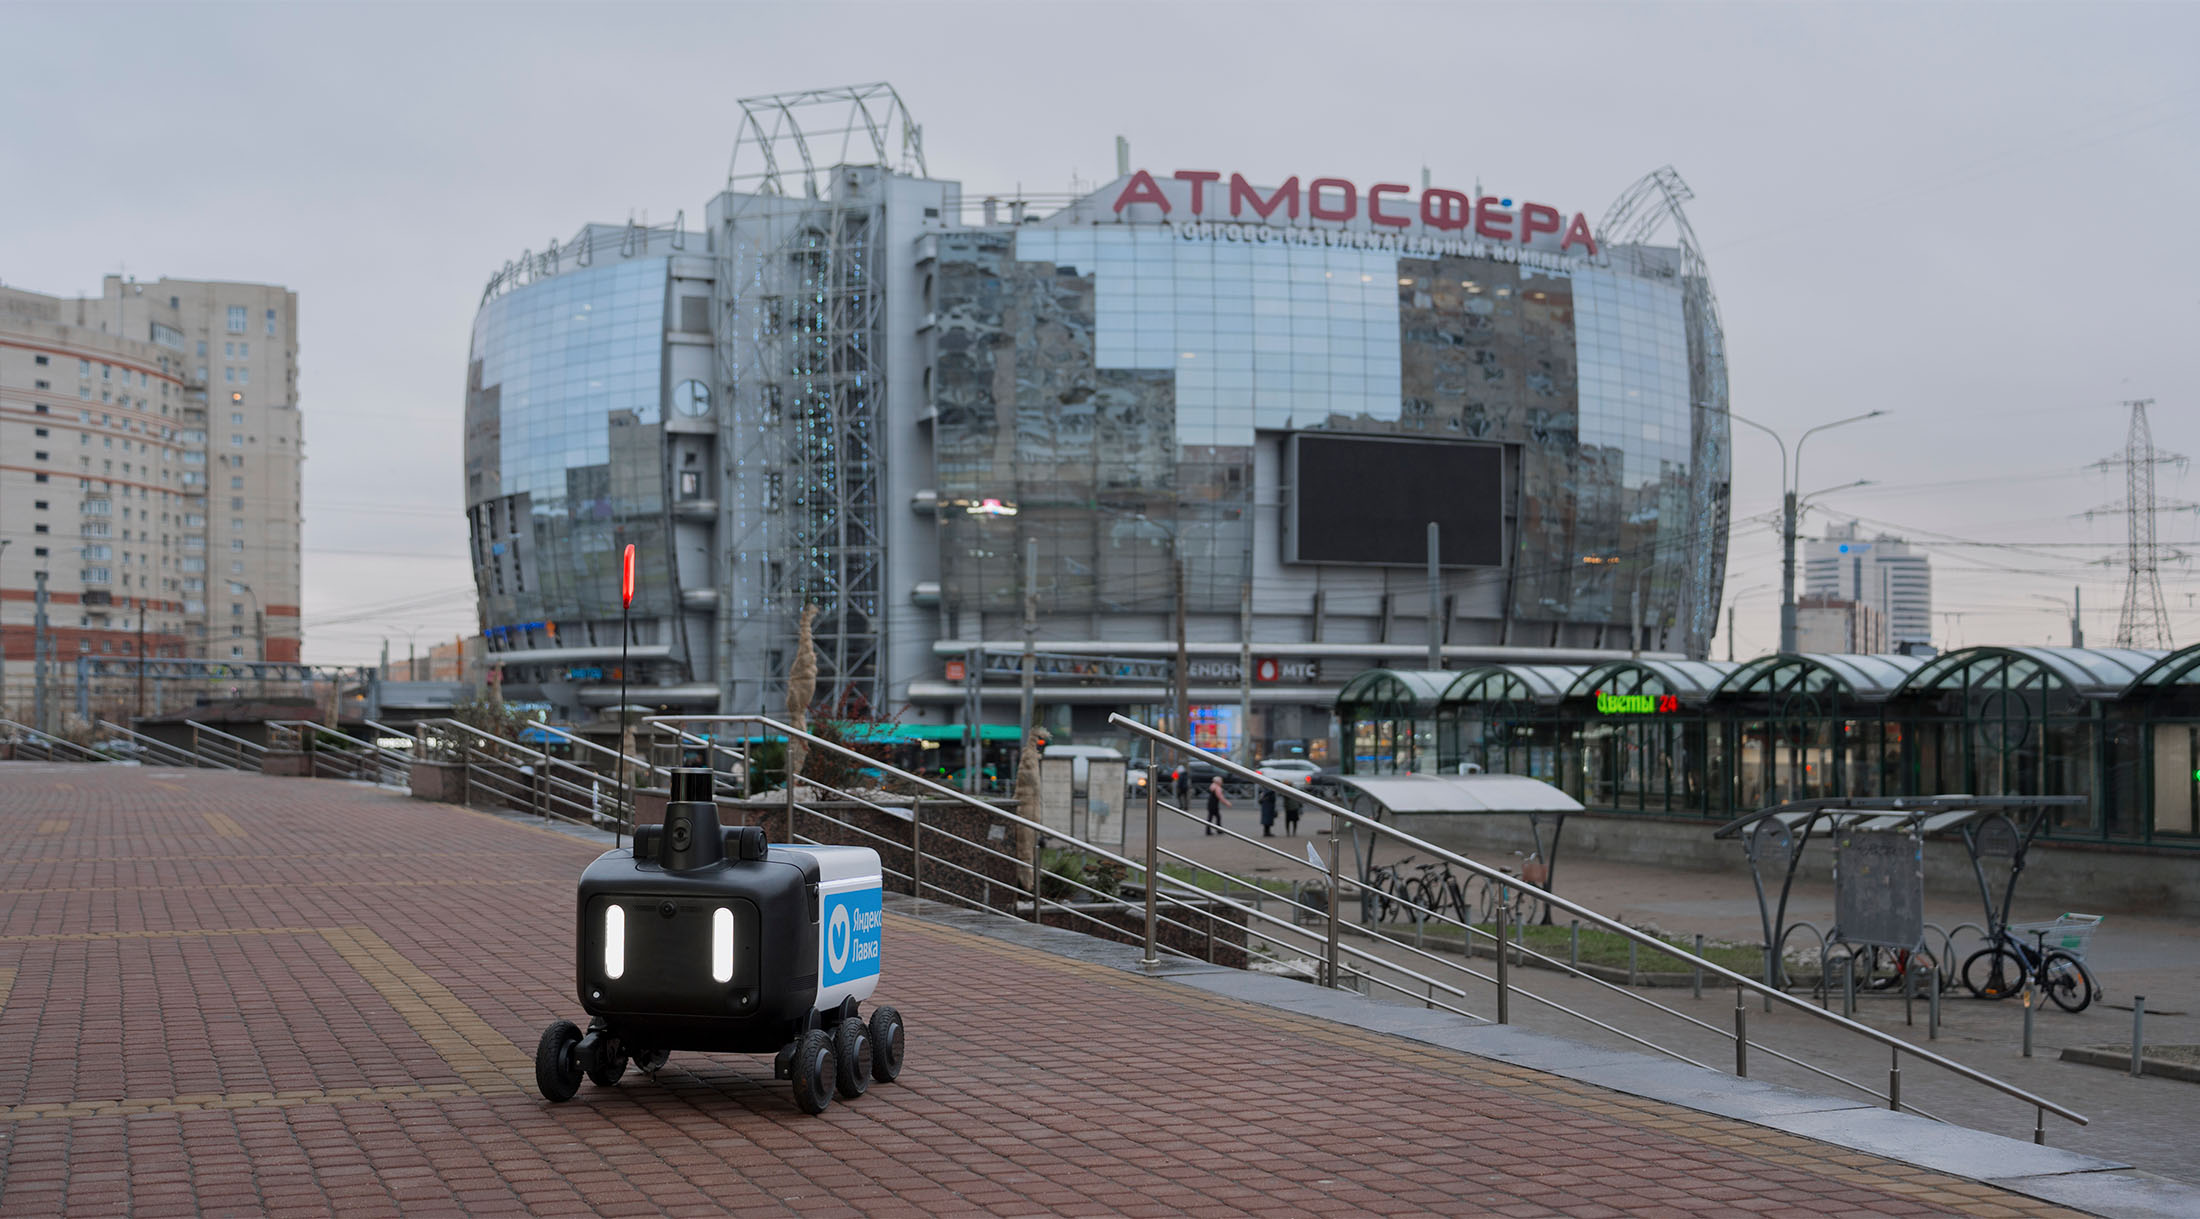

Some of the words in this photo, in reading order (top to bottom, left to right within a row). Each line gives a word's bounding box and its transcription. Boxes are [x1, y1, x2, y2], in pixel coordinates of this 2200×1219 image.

[1112, 169, 1599, 256] АТМОСФЕРА
[1282, 663, 1317, 677] МТС
[1596, 692, 1655, 714] Цветы
[1659, 694, 1678, 712] 24
[852, 937, 878, 963] Лавка
